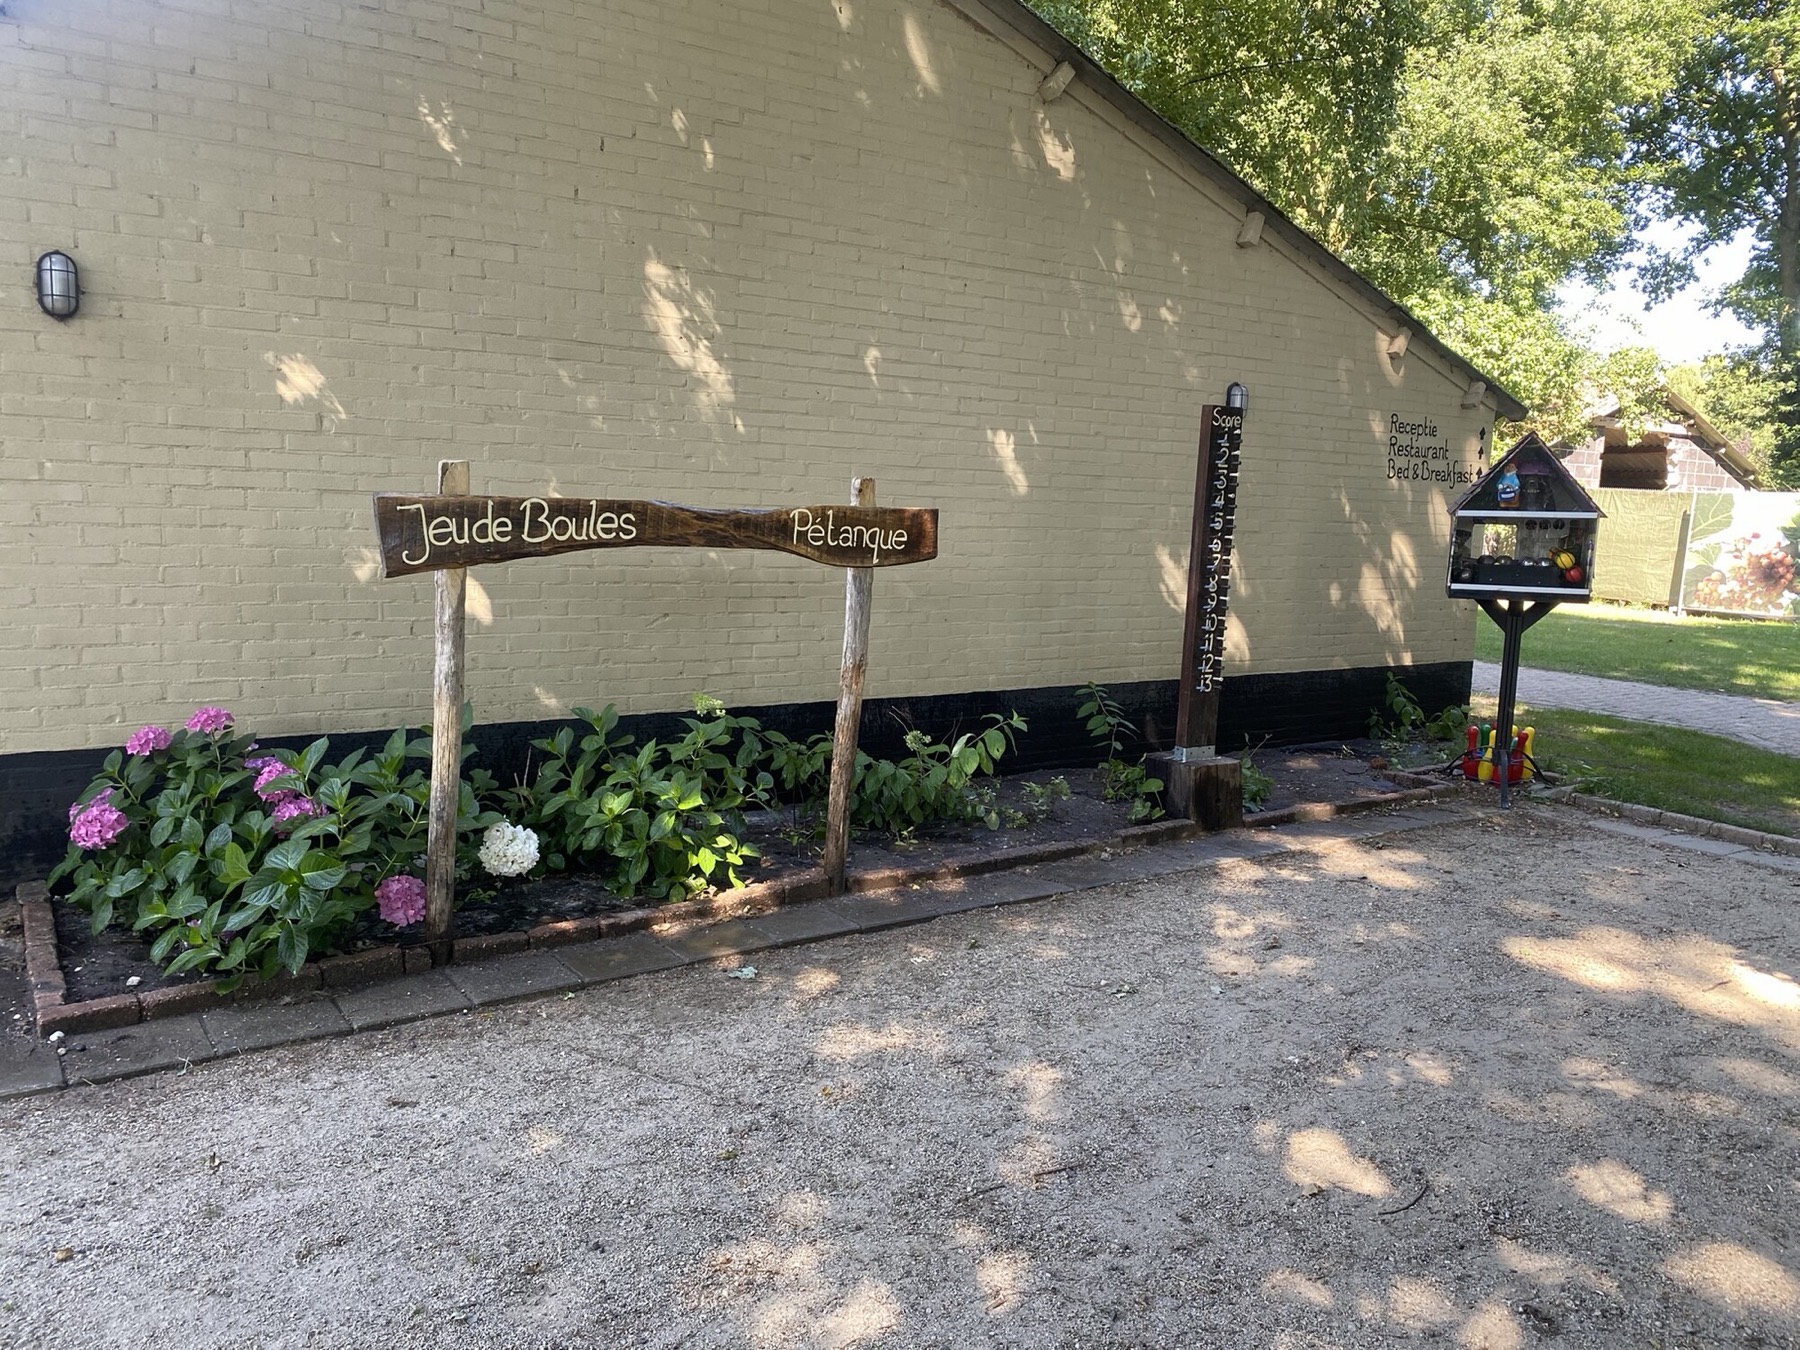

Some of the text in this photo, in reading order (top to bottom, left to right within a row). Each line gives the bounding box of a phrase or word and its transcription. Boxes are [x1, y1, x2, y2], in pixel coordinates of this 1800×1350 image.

[1212, 407, 1242, 427] Score
[1390, 413, 1438, 442] Receptie
[1388, 436, 1449, 460] Restaurant
[1217, 448, 1229, 468] 2
[1216, 470, 1227, 489] 3
[1387, 458, 1474, 489] Bed & Breakfast
[1215, 491, 1225, 508] 4
[519, 497, 637, 543] Boules
[1213, 512, 1223, 530] 5
[789, 508, 908, 565] Pétanque
[1212, 533, 1221, 552] 6
[1211, 554, 1221, 571] 7
[1208, 574, 1218, 592] 8
[1207, 593, 1217, 612] 9
[1204, 613, 1218, 631] 10
[1203, 633, 1214, 651] 11
[1201, 654, 1214, 673] 12
[1199, 674, 1213, 692] 13
